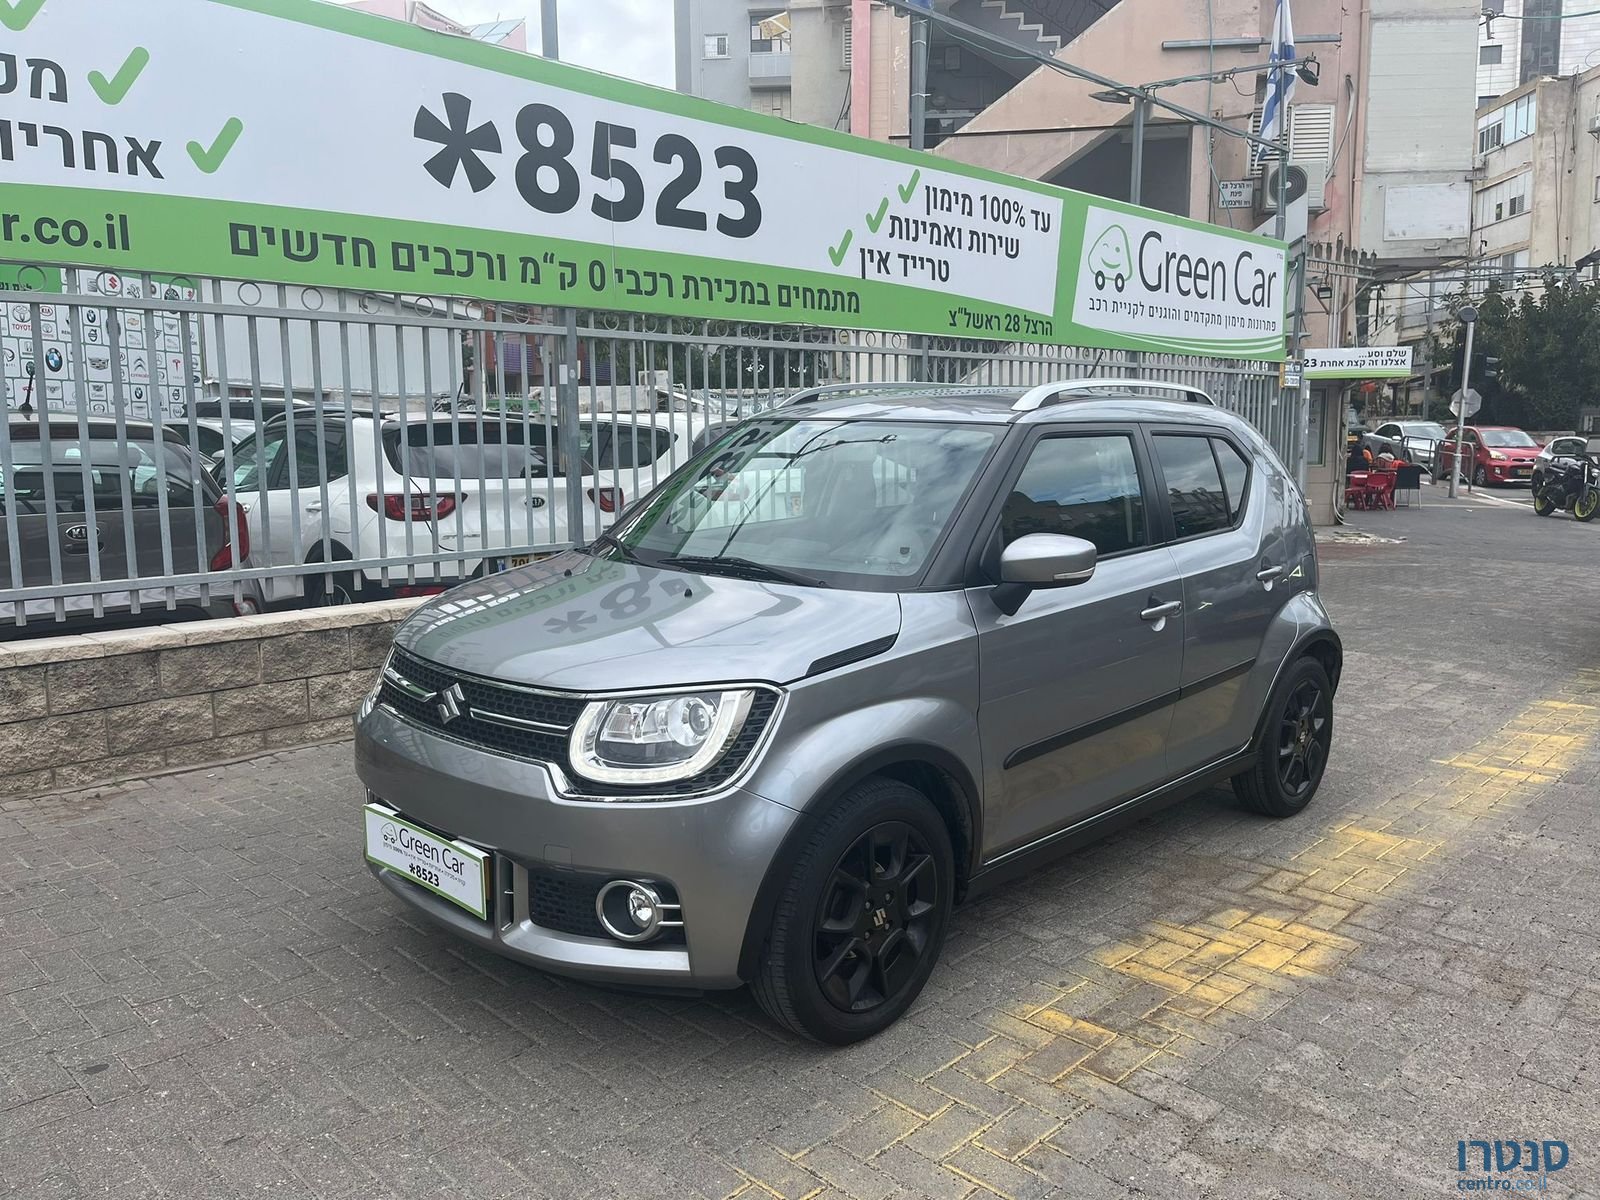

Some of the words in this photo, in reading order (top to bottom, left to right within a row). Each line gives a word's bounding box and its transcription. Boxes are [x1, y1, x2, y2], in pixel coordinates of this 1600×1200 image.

[925, 184, 973, 216] מימון
[980, 194, 1025, 227] 100%
[889, 214, 962, 250] ואמינות
[1030, 208, 1051, 233] עד
[229, 222, 376, 269] חדשים
[968, 229, 1020, 259] שירות
[391, 241, 506, 281] ורכבים
[859, 248, 891, 279] אין
[898, 253, 950, 282] טרייד
[1138, 231, 1226, 302] Green
[1234, 250, 1277, 308] Car
[588, 259, 606, 292] 0
[615, 268, 674, 298] רכבי
[682, 274, 771, 306] במכירת
[777, 285, 861, 313] מתמחים
[1089, 297, 1108, 312] רכב
[1111, 300, 1144, 319] לקניית
[1148, 305, 1181, 321] והוגנים
[1184, 310, 1222, 327] מתקדמים
[1004, 313, 1020, 333] 28
[1023, 314, 1053, 337] הרצל
[1224, 314, 1245, 329] מימון
[1247, 317, 1277, 332] פתרונות
[1304, 358, 1317, 368] 23
[1320, 359, 1344, 367] אחרת
[1346, 359, 1366, 368] קצת
[1380, 357, 1406, 366] אצלנו
[399, 828, 440, 863] Green
[442, 848, 465, 876] Car
